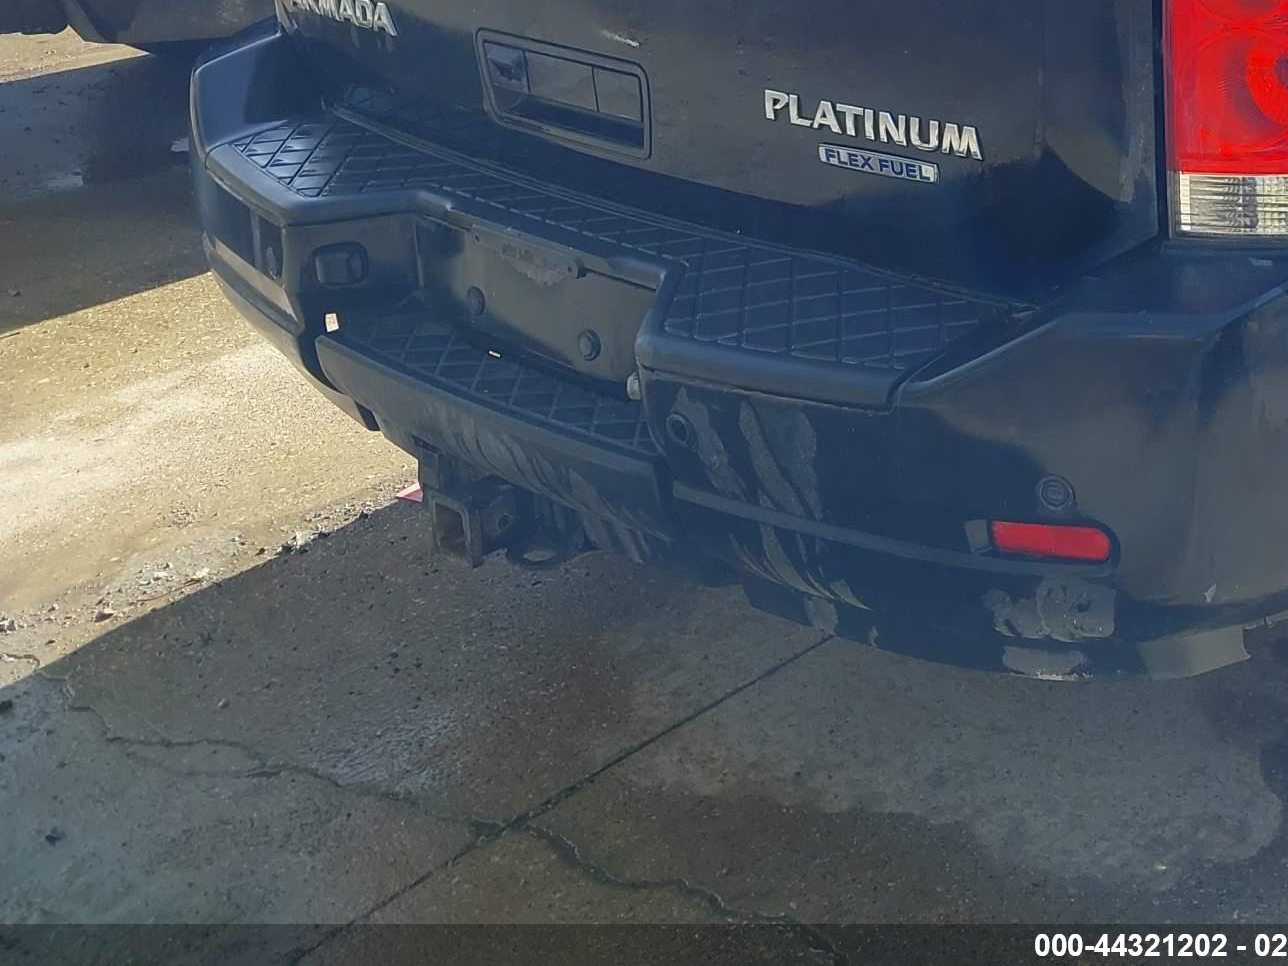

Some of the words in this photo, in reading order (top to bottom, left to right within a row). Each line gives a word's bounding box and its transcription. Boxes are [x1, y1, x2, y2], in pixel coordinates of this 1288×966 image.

[764, 89, 984, 161] PLATINUM
[824, 148, 874, 171] FLEX
[878, 158, 931, 182] FUEL
